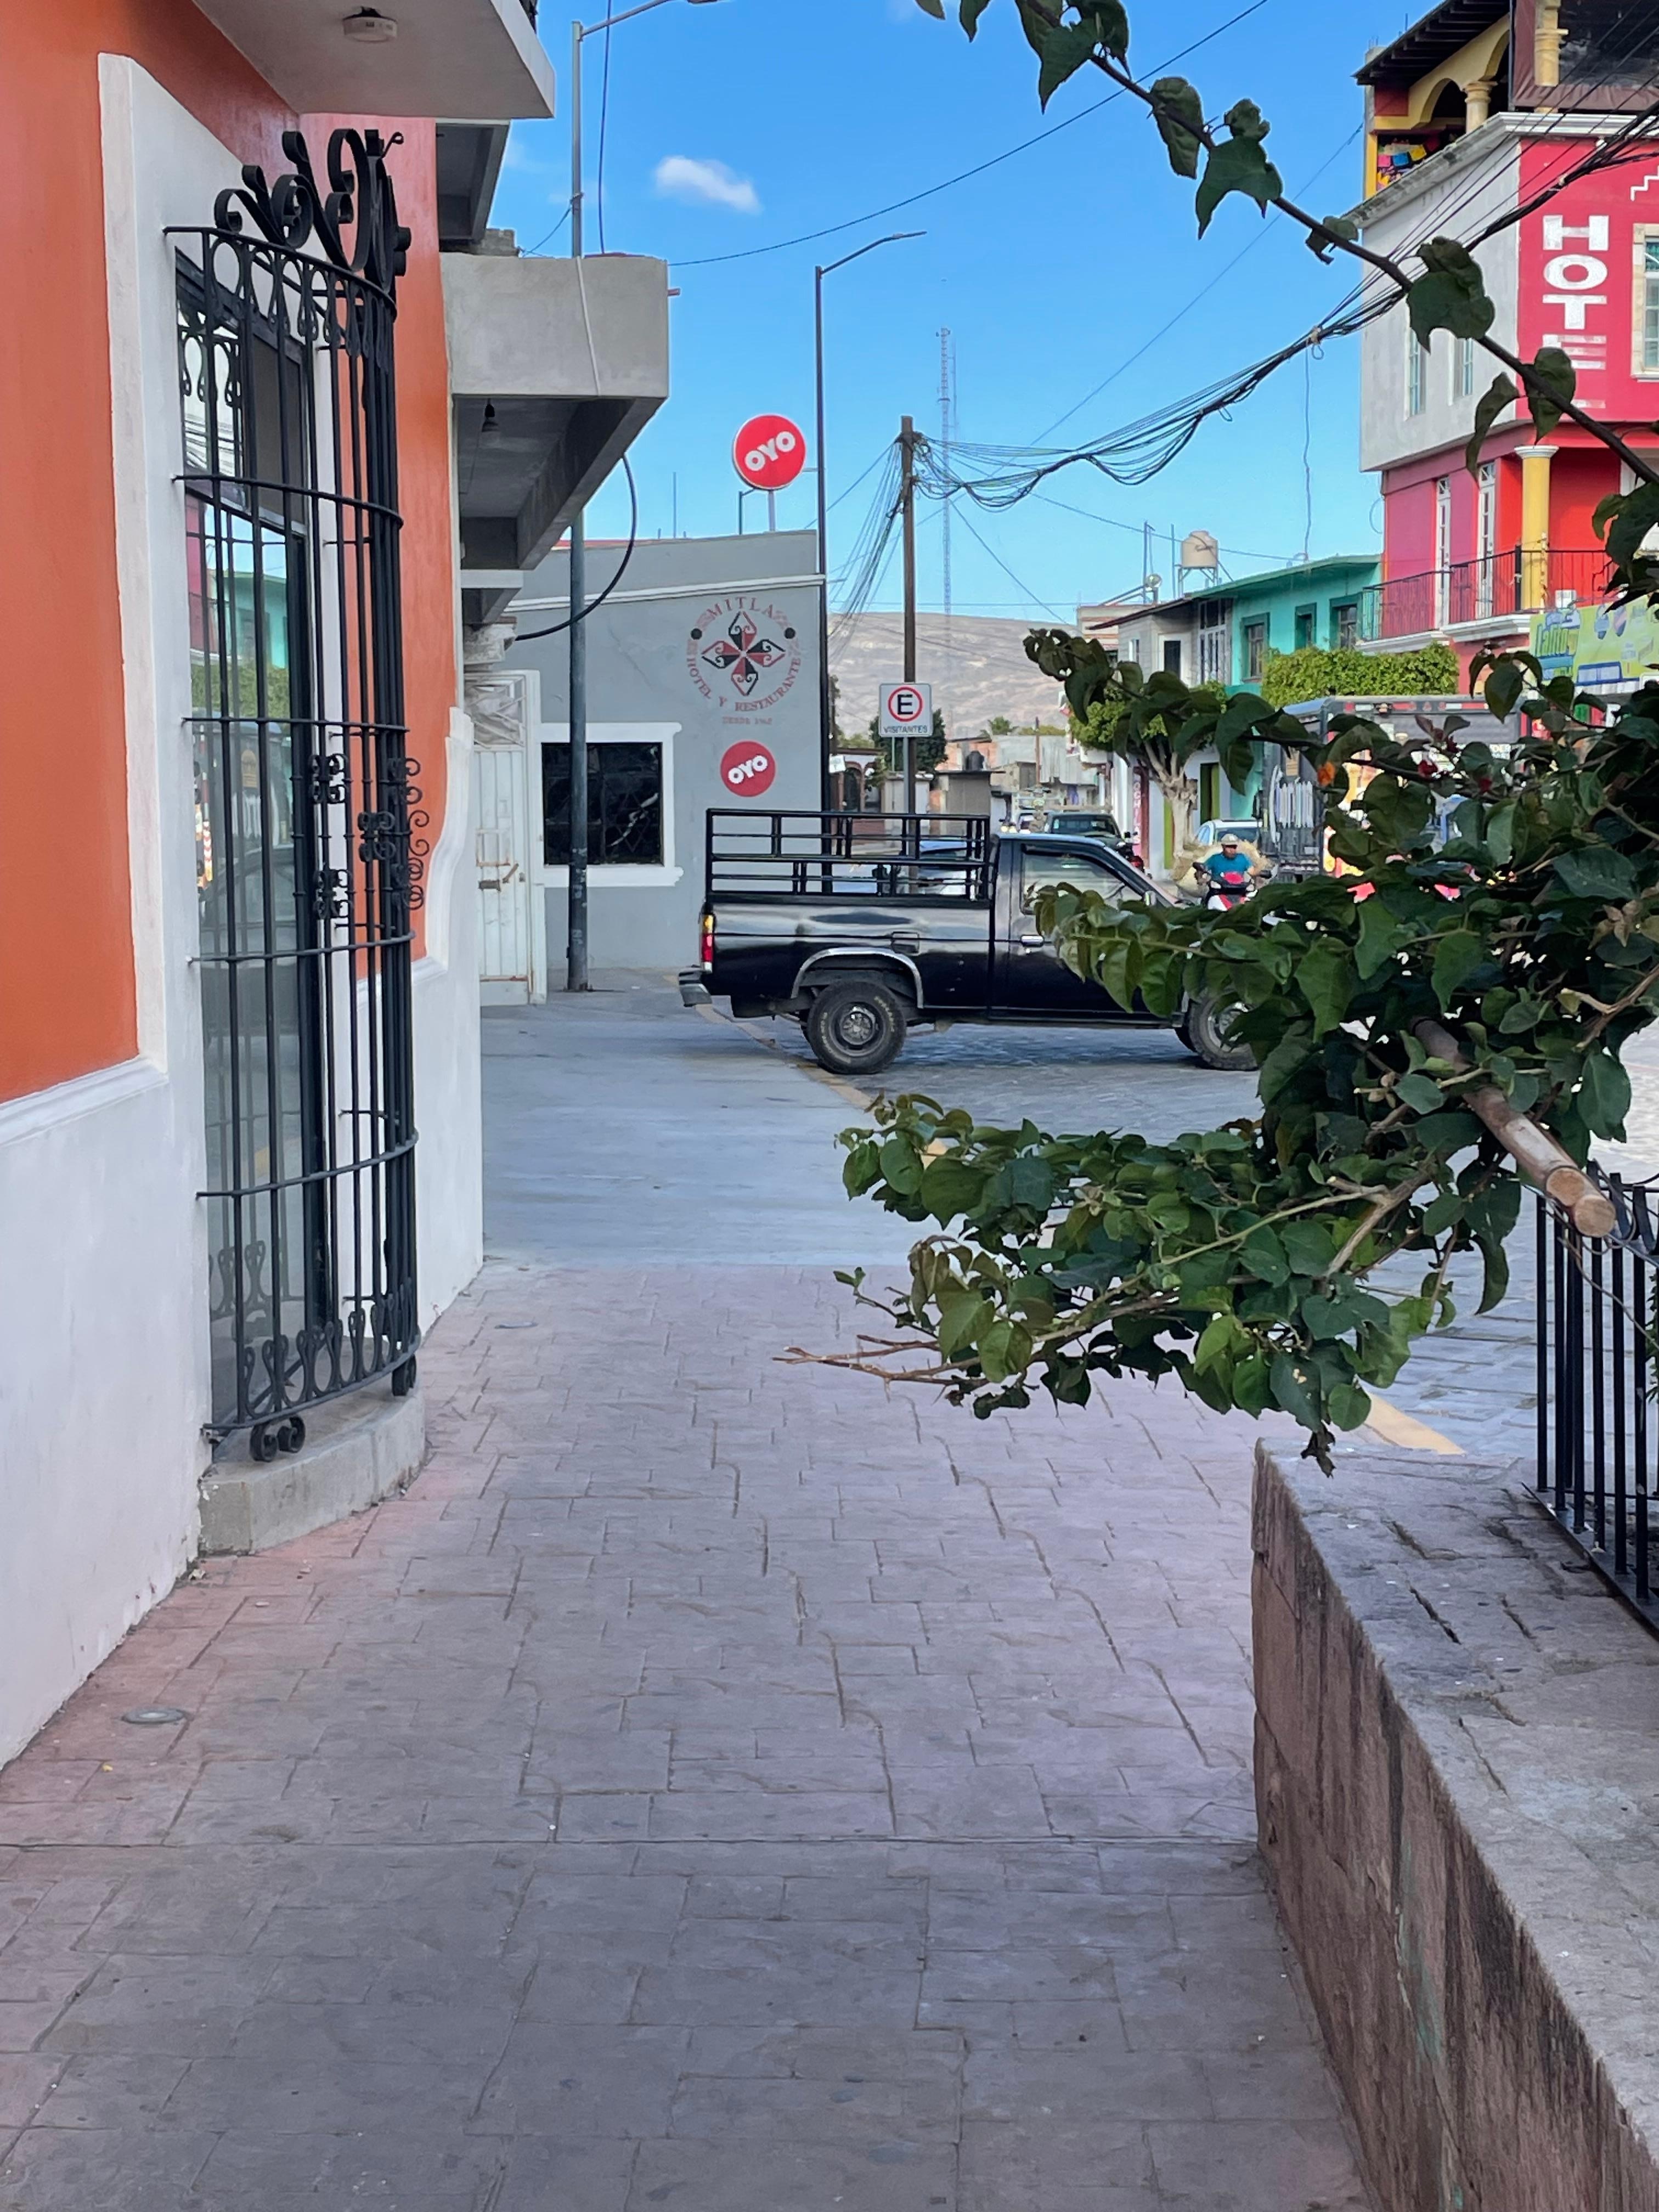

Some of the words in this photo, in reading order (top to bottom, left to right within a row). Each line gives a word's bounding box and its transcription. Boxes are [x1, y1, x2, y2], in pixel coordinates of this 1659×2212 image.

[744, 431, 795, 471] OYO
[707, 596, 774, 619] MITLA
[687, 658, 712, 699] HOTEL
[719, 696, 727, 707] Y
[735, 658, 801, 712] RESTAURANTE
[897, 694, 913, 715] E
[883, 725, 928, 734] VISITANTES
[728, 755, 768, 784] OYO
